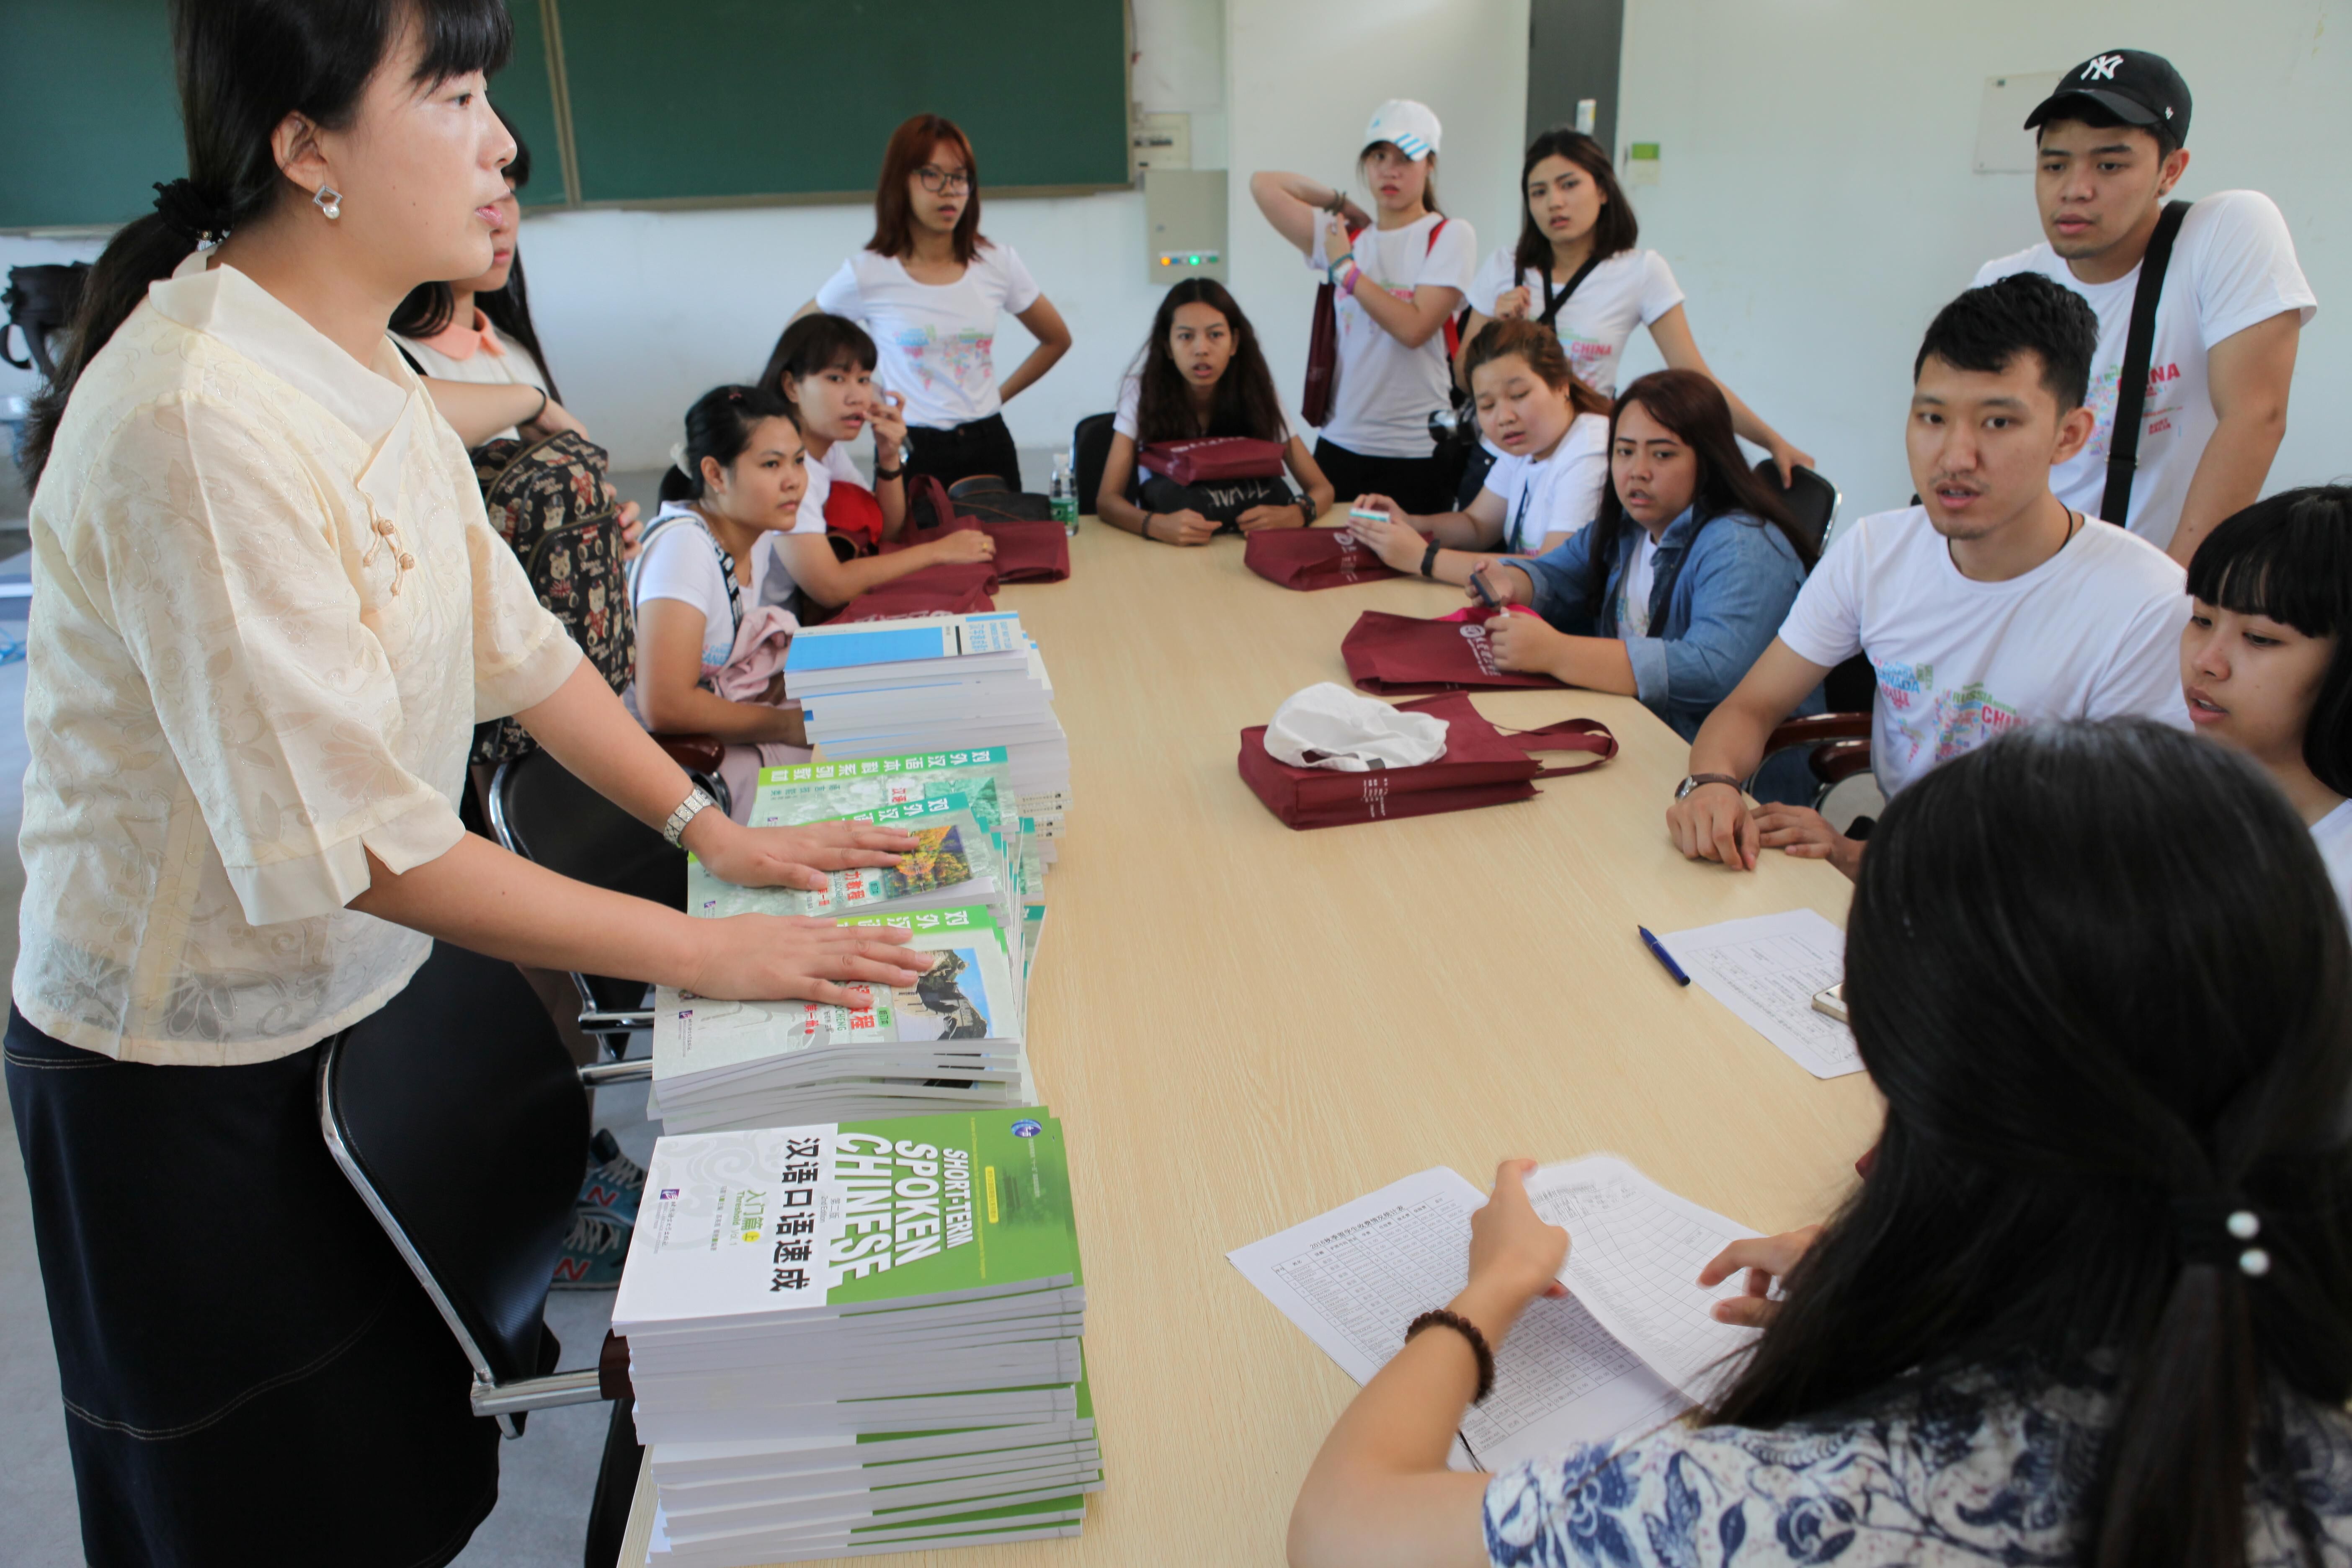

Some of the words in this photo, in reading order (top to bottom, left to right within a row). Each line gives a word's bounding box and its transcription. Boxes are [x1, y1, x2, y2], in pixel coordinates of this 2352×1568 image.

[1572, 341, 1612, 355] CHINA
[1953, 690, 1993, 704] RUSSIA
[844, 870, 866, 901] 力教程
[586, 1186, 617, 1207] N
[732, 1191, 745, 1226] Threshold
[740, 1189, 767, 1231] 入门篇
[827, 1132, 892, 1290] CHINESE
[895, 1140, 941, 1267] SPOKEN
[942, 1148, 973, 1249] SHORT-TERM
[769, 1137, 821, 1292] 汉语口语速成
[554, 1256, 591, 1281] N
